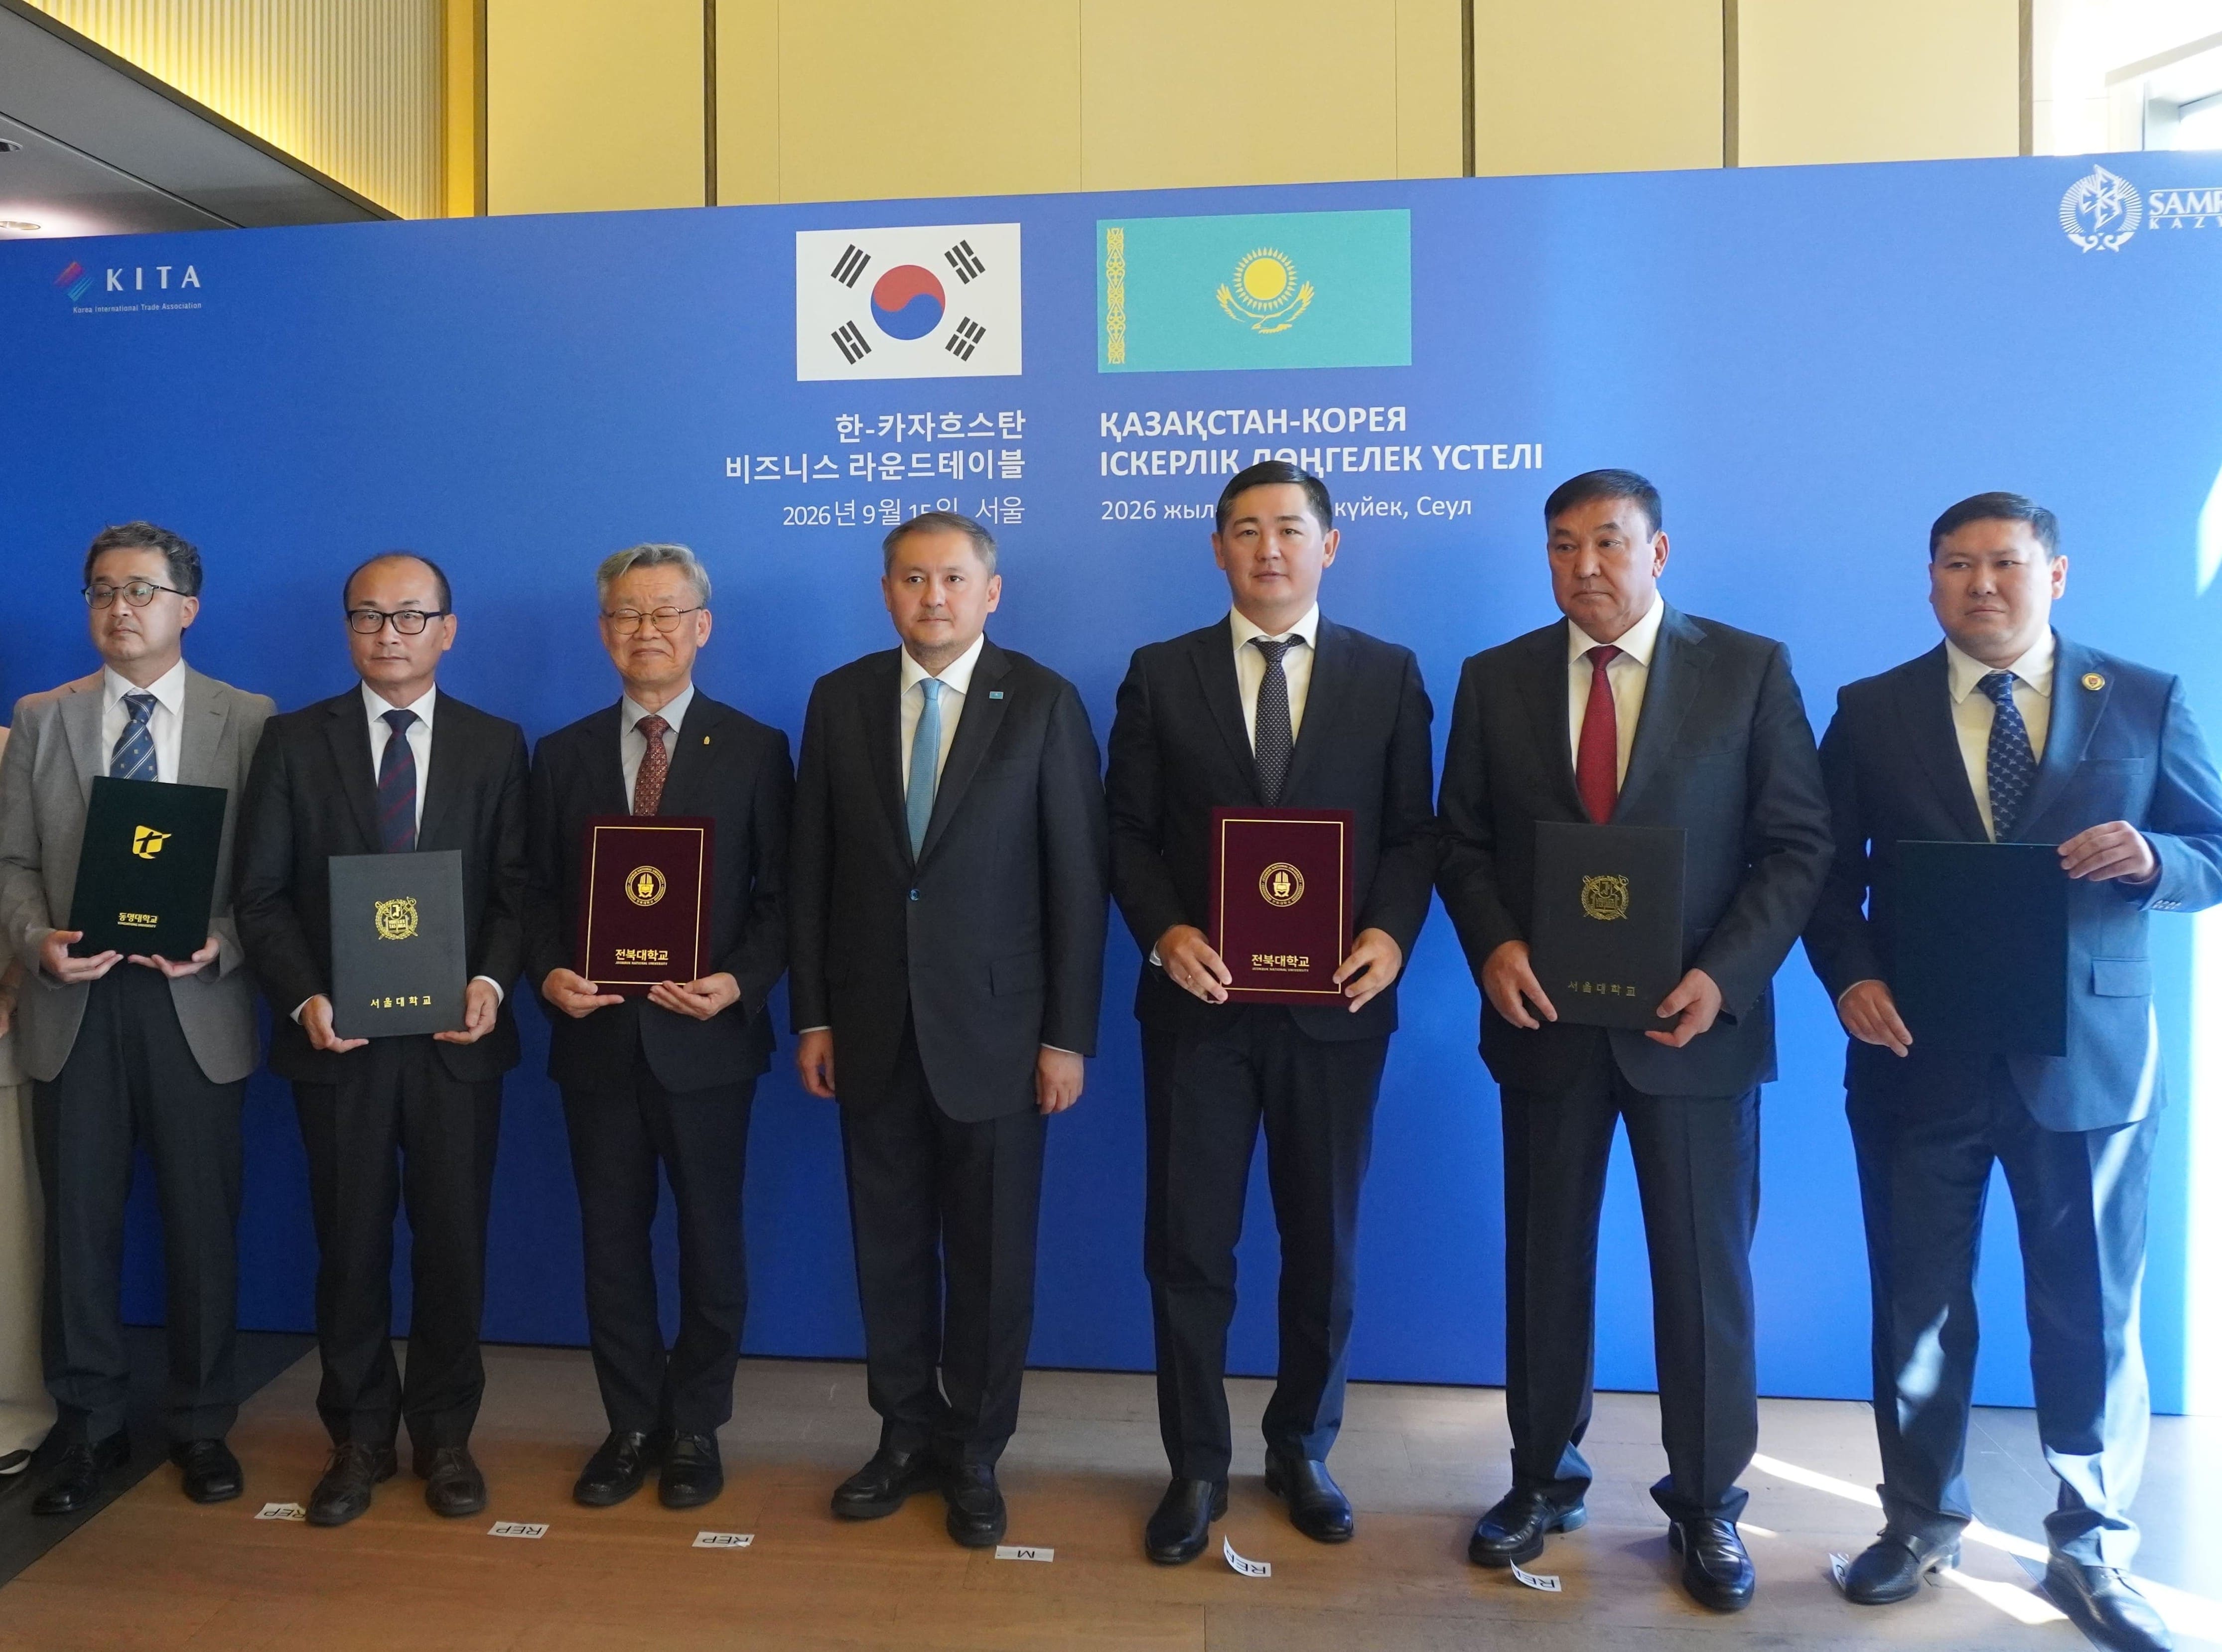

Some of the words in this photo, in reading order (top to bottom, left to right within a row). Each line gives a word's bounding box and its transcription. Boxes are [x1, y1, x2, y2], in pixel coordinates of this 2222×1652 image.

[107, 265, 200, 291] KITA
[835, 410, 1026, 443] 한-카자흐스탄
[1101, 406, 1406, 442] ҚАЗАҚСТАН-КОРЕЯ
[726, 453, 839, 484] 비즈니스
[849, 449, 1026, 482] 라운드테이블
[1101, 449, 1240, 476] ІСКЕРЛІК
[1431, 443, 1542, 470] ҮСТЕЛІ
[862, 498, 901, 526] 9월
[975, 496, 1025, 524] 서울
[1102, 500, 1156, 520] 2026
[1163, 504, 1216, 519] жыл
[1335, 497, 1408, 521] күйек,
[1417, 496, 1471, 520] Сеул
[119, 912, 157, 924] 동명대학교
[615, 949, 669, 961] 전북대학교
[1251, 954, 1310, 967] 전북대학교
[1568, 981, 1636, 996] 서울대학교
[370, 995, 431, 1009] 서울대학교
[496, 1525, 543, 1535] REP
[1227, 1550, 1266, 1574] REP
